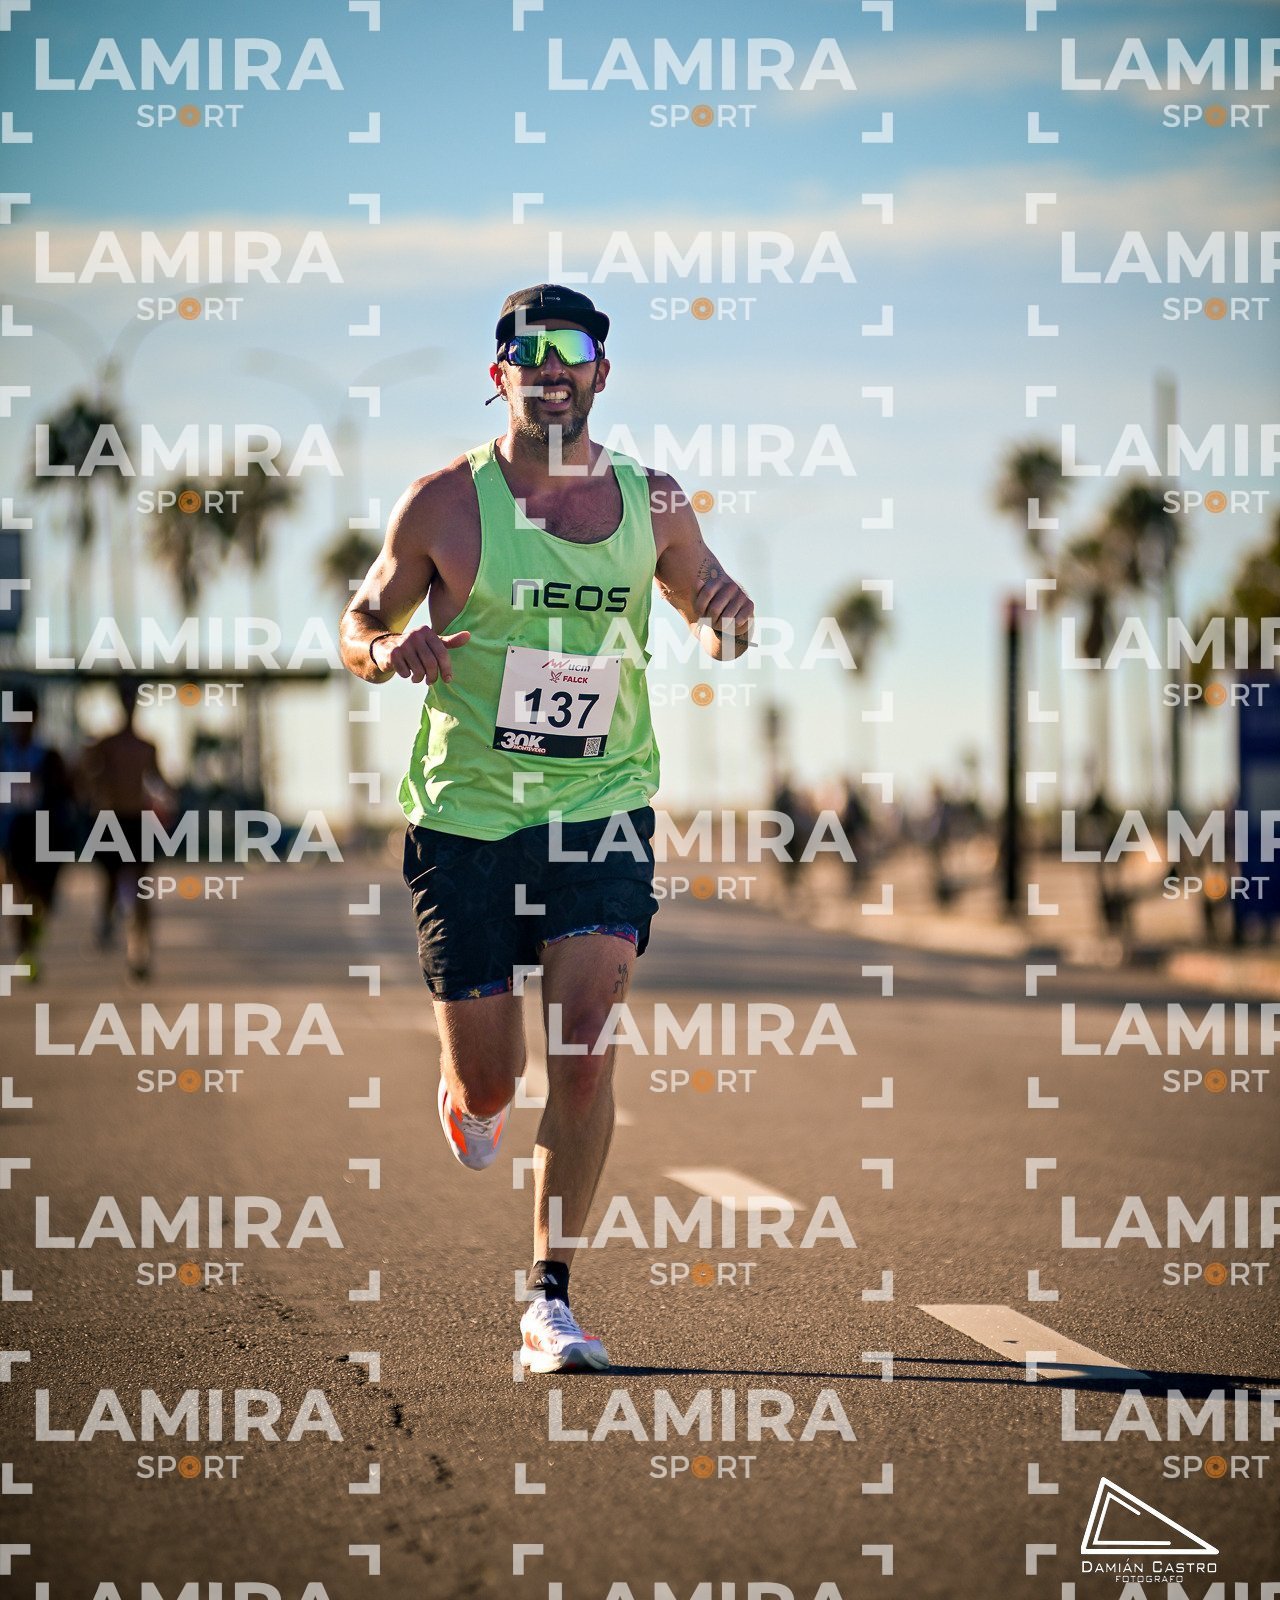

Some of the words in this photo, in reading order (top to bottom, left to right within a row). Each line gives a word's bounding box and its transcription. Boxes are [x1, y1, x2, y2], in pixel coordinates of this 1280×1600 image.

[563, 675, 588, 683] FALCK
[524, 688, 600, 729] 137
[500, 732, 545, 749] 30K
